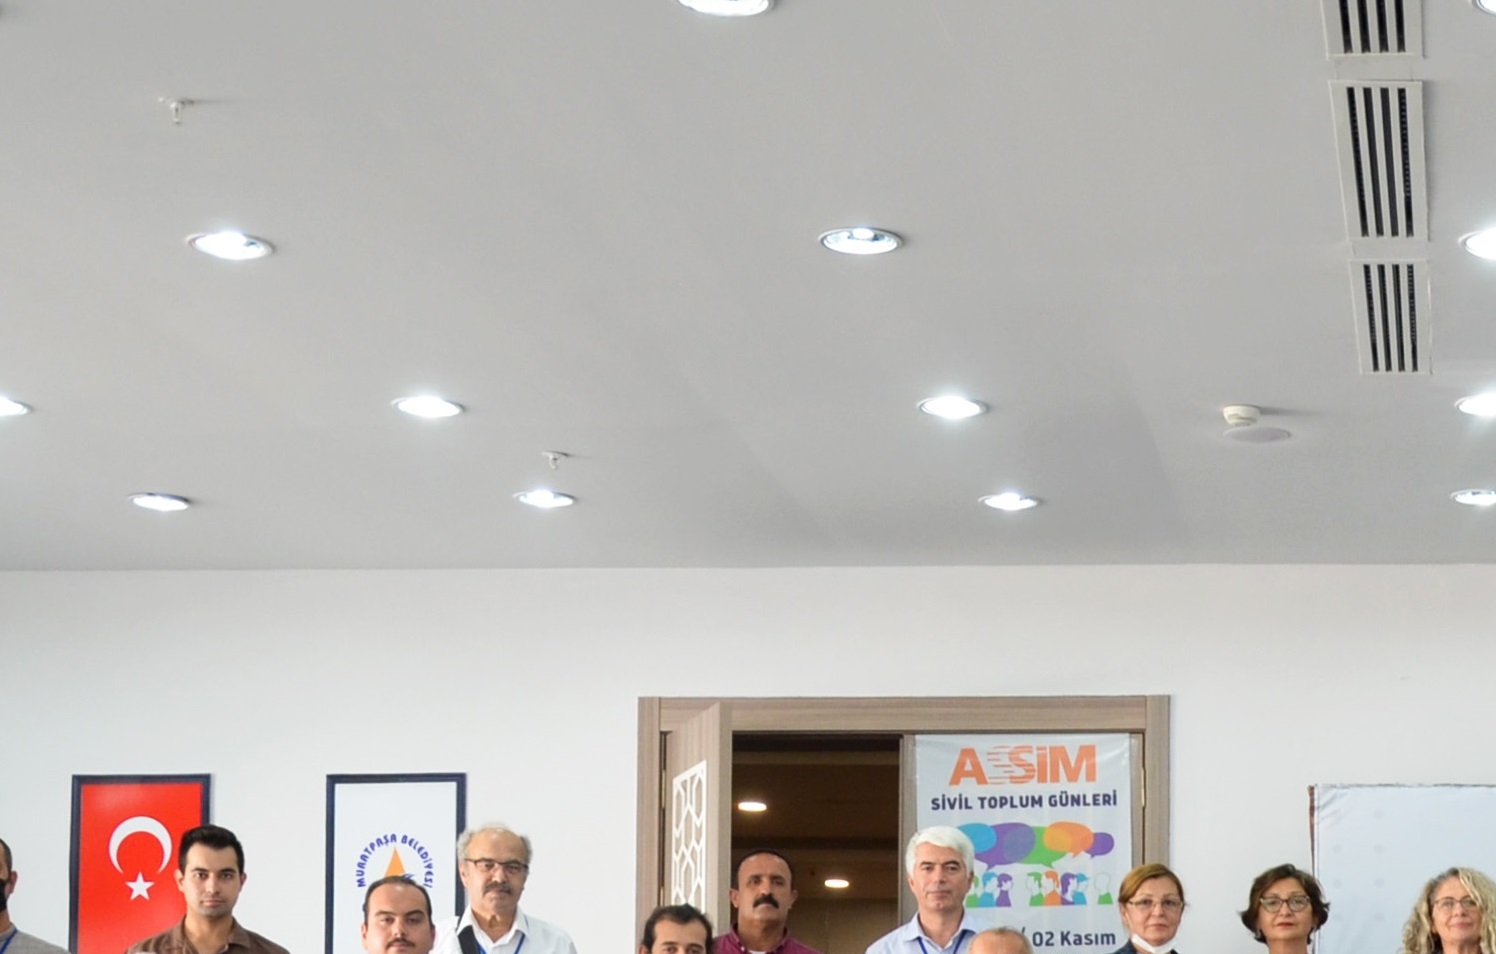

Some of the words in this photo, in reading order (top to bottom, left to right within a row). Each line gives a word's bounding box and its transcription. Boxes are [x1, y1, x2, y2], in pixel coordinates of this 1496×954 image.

[931, 794, 973, 811] SİVİL
[978, 793, 1042, 810] TOPLUM
[1048, 790, 1117, 808] GÜNLERİ
[355, 833, 397, 888] MURATPAŞA
[1032, 931, 1054, 947] 02
[1060, 931, 1116, 946] Kasım
